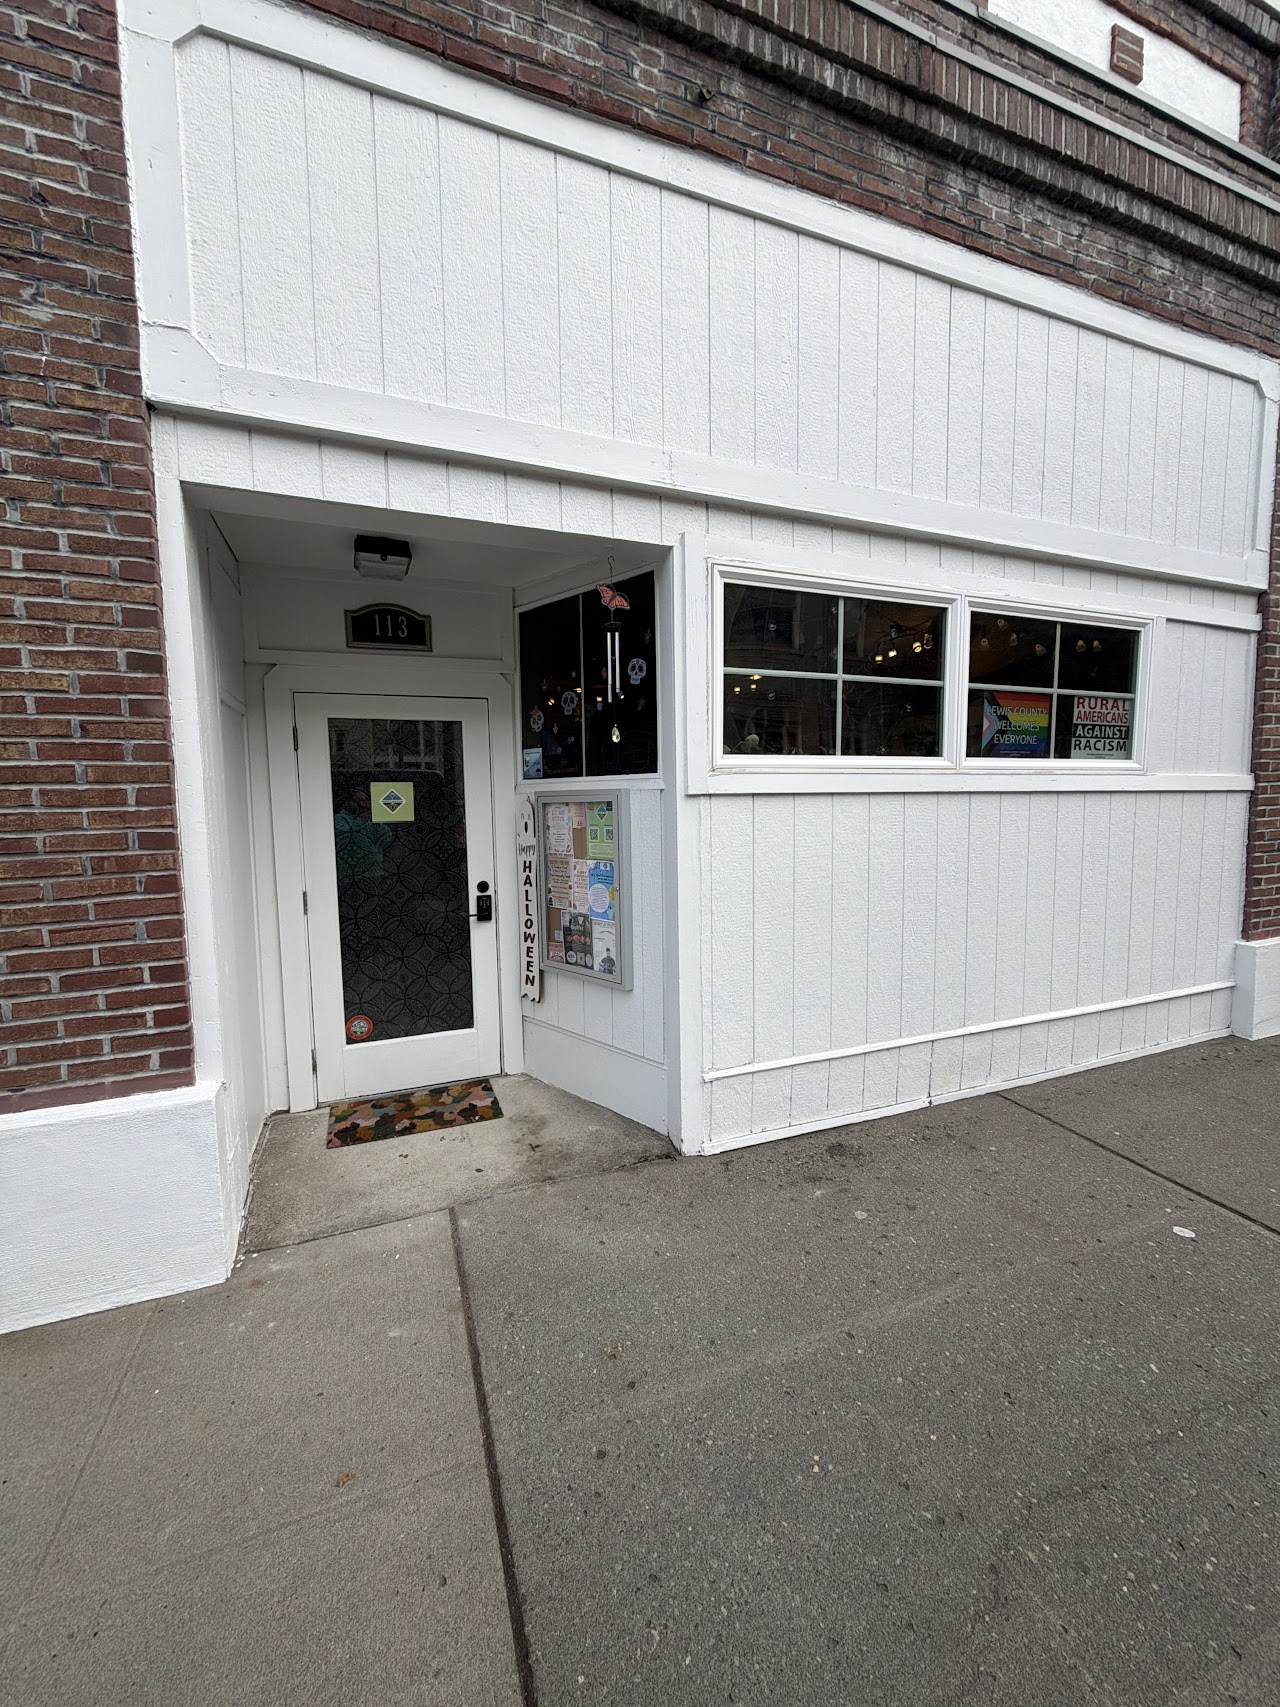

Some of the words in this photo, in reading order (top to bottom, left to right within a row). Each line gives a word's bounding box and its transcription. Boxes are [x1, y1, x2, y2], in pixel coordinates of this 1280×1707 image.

[374, 613, 408, 638] 113
[986, 705, 1012, 716] LEWIS
[1013, 706, 1048, 717] COUNTY
[1076, 696, 1130, 711] RURAL
[1075, 709, 1129, 724] AMERICANS
[994, 719, 1040, 732] WELCOMES
[1075, 724, 1128, 739] AGAINST
[993, 733, 1038, 745] EVERYONE
[1073, 739, 1127, 752] RACISM
[522, 860, 536, 987] HALLOWEEN
